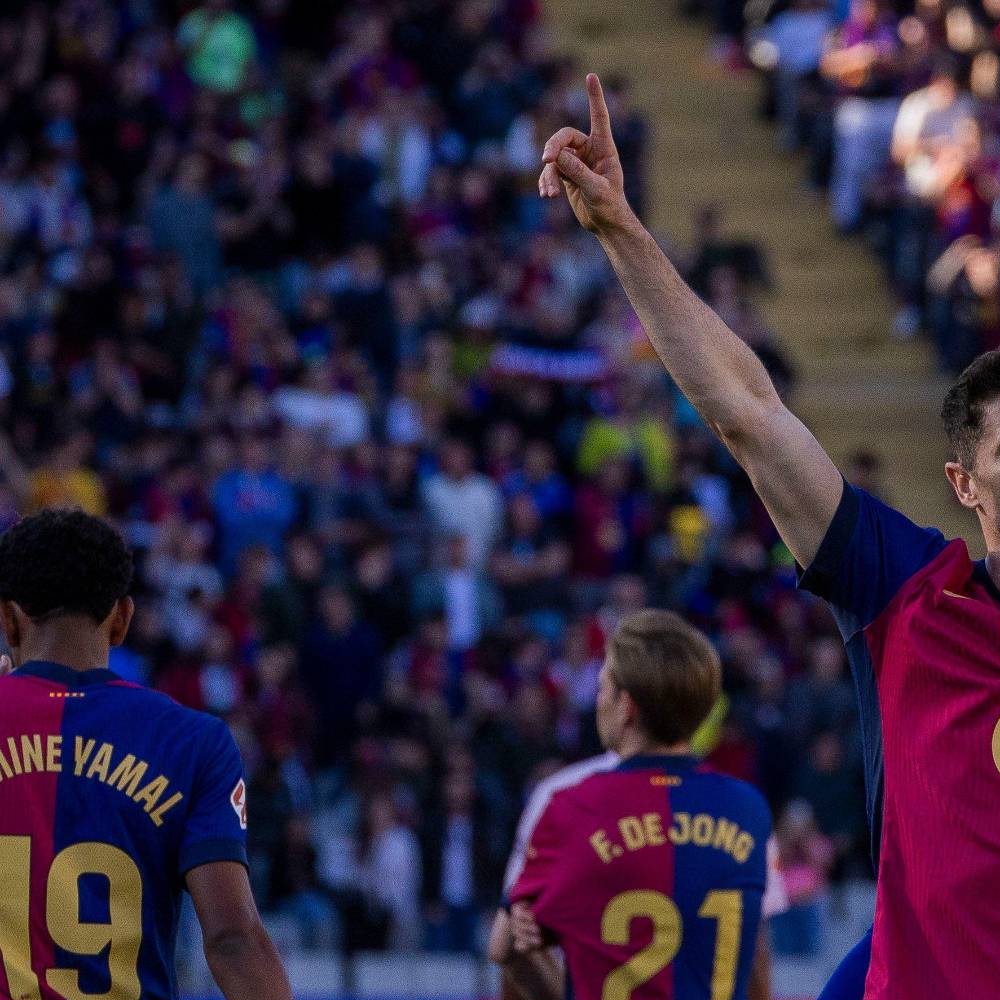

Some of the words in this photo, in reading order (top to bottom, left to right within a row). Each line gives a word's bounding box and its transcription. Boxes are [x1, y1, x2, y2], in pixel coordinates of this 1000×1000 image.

[74, 735, 183, 827] YAMAL
[589, 829, 624, 864] F.
[618, 812, 667, 850] DE
